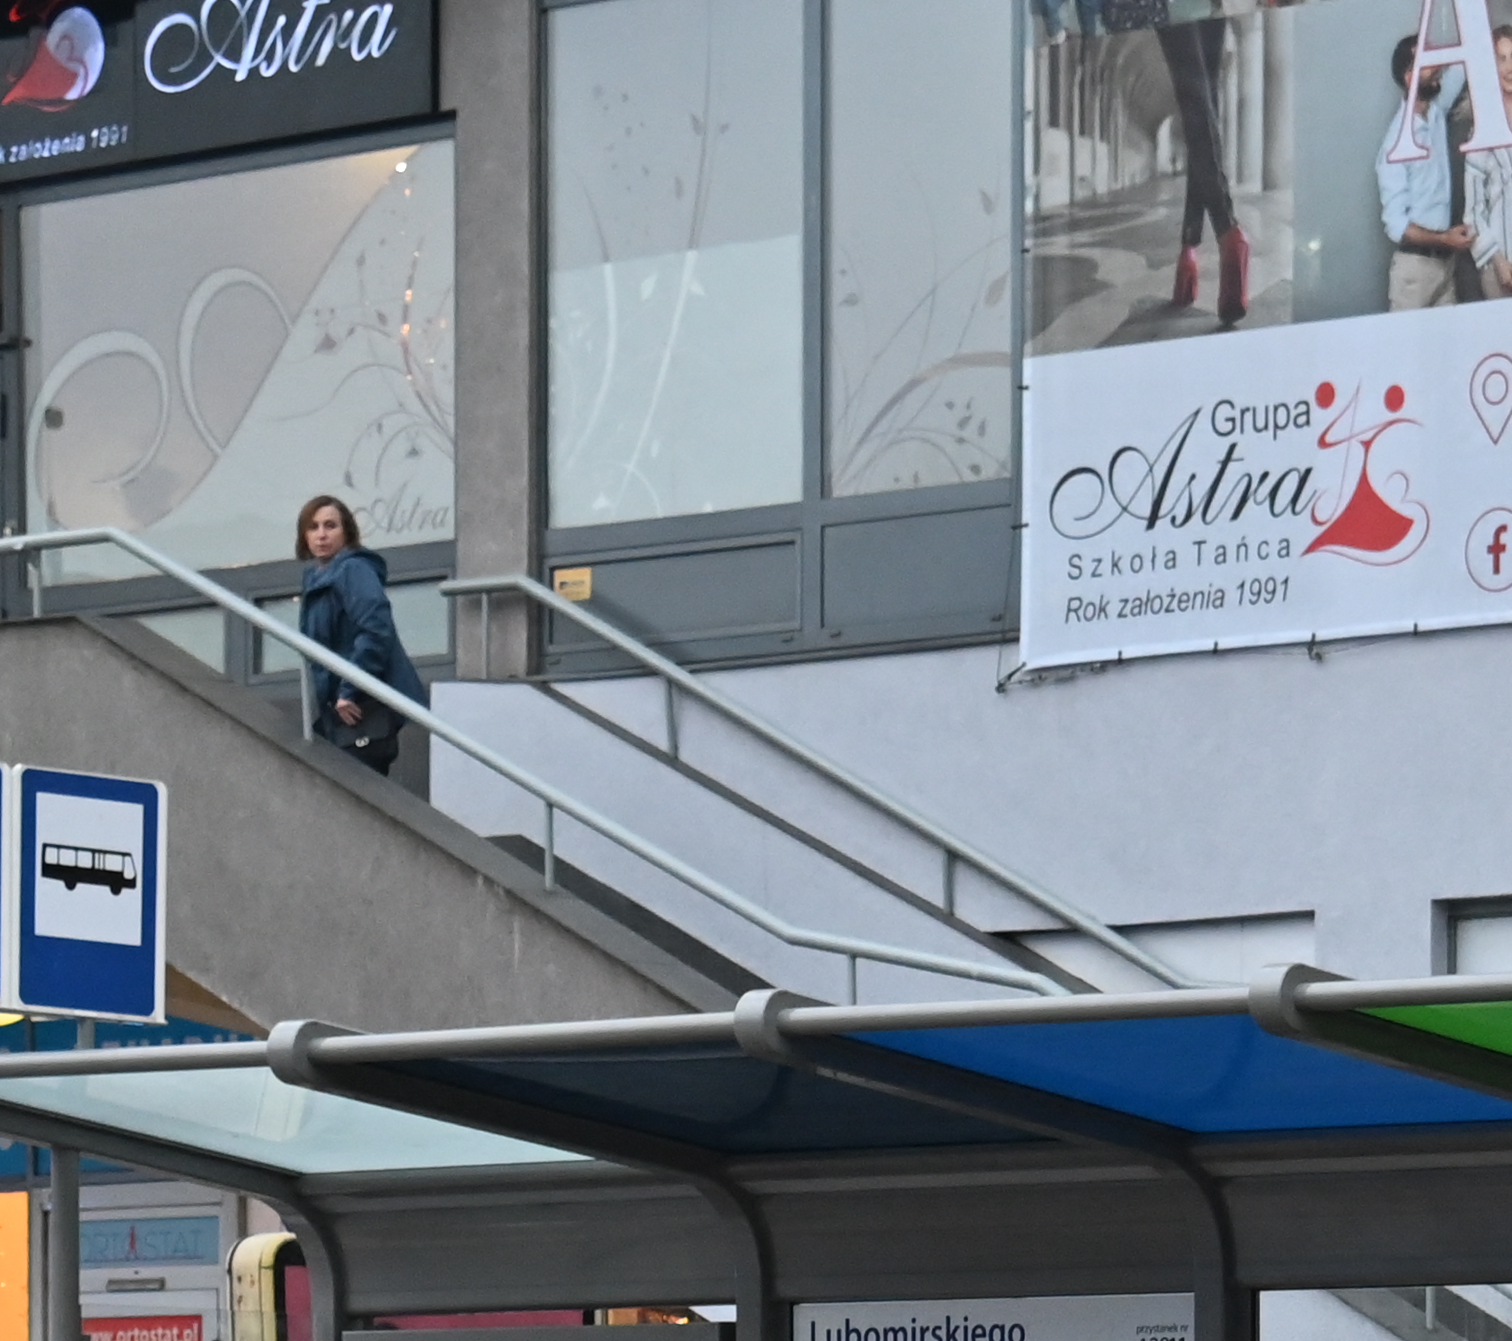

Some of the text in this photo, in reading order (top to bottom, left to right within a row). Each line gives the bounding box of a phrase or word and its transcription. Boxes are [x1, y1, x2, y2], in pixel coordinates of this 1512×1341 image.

[144, 0, 397, 93] Astra
[1211, 398, 1312, 441] Grupa
[1049, 405, 1318, 540] Astra
[1066, 536, 1290, 581] Szkoła Tańca
[1064, 575, 1290, 625] Rok założenia 1991
[1136, 1323, 1178, 1335] przystanek
